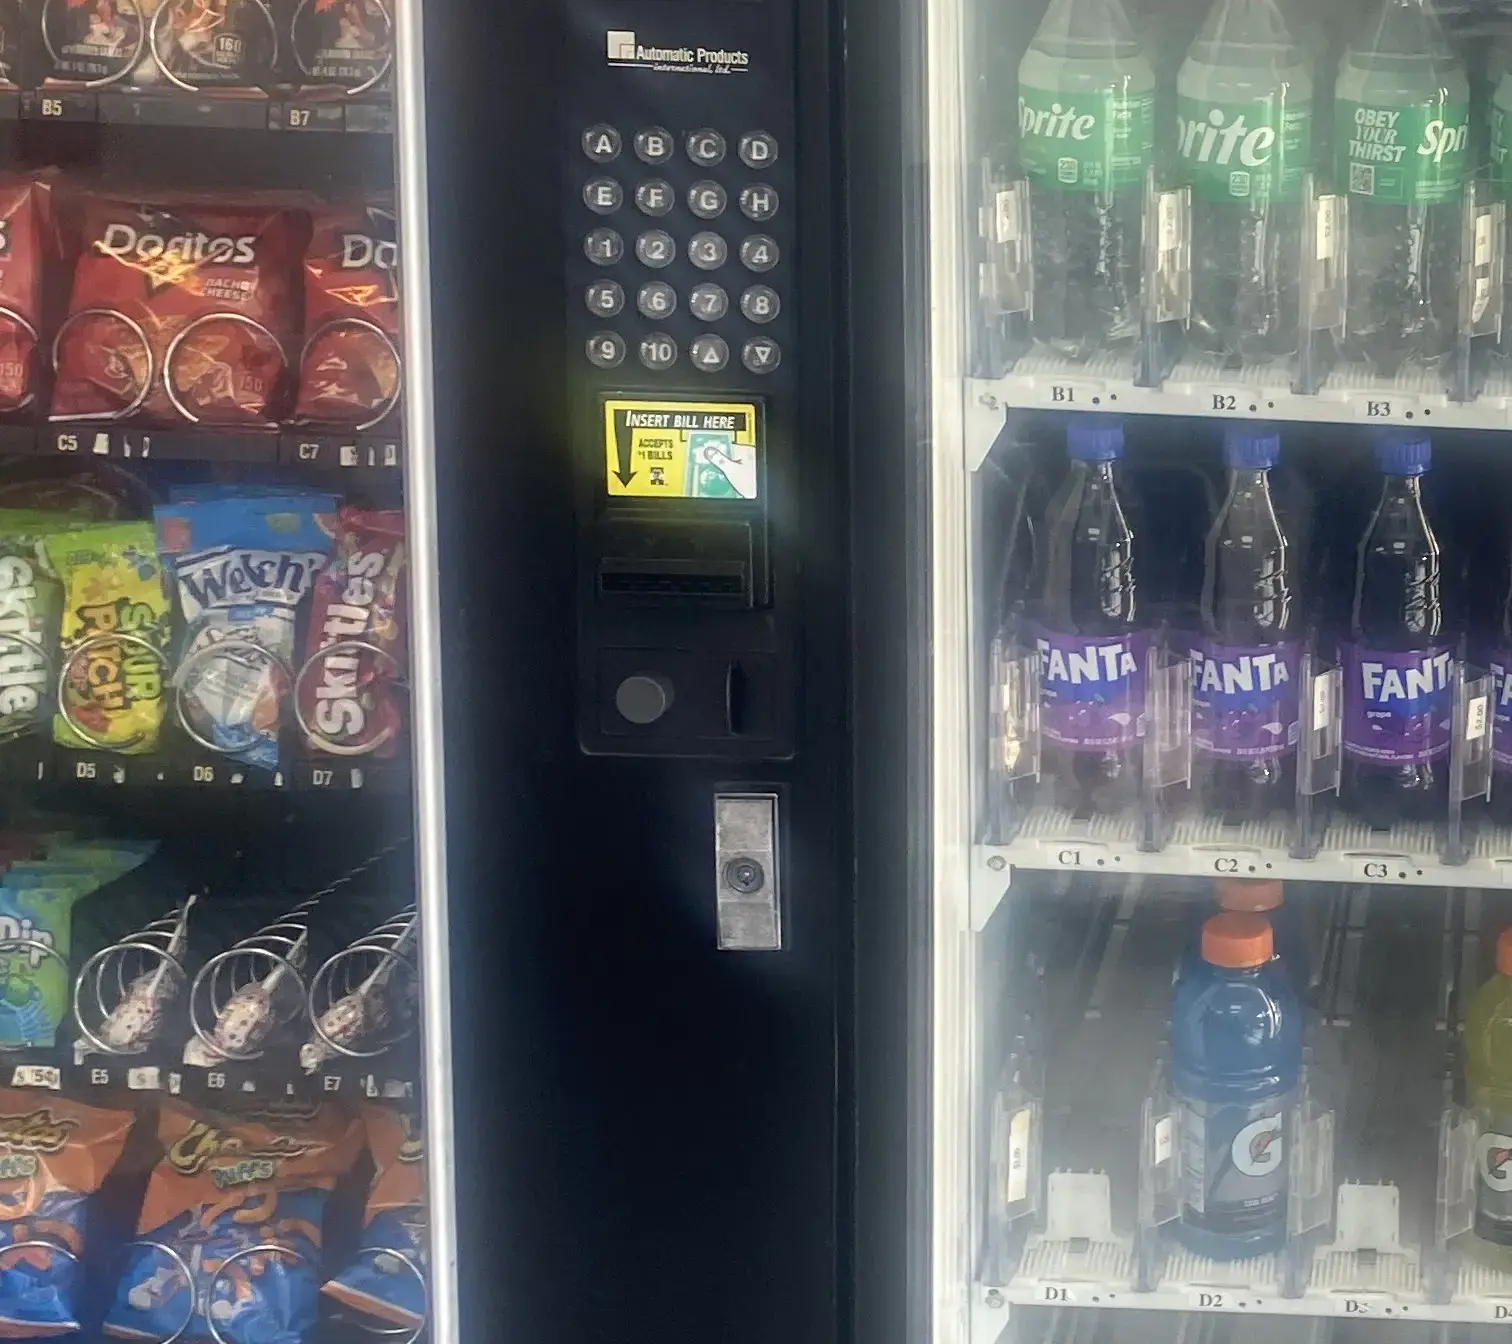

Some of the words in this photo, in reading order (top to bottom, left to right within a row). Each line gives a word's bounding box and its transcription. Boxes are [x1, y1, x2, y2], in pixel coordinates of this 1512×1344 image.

[637, 46, 694, 62] Automatic
[697, 49, 748, 65] Products
[1354, 108, 1399, 128] OBEY
[1355, 127, 1397, 144] YOUR
[595, 134, 612, 153] A
[648, 137, 663, 156] B
[700, 139, 716, 158] C
[753, 141, 767, 160] D
[1348, 140, 1406, 163] THIRST
[598, 187, 613, 206] E
[649, 189, 663, 208] F
[701, 191, 718, 210] G
[753, 193, 768, 211] H
[104, 224, 257, 263] Doritos
[602, 239, 611, 257] 1
[652, 241, 665, 259] 2
[704, 243, 715, 261] 3
[753, 245, 768, 263] 4
[601, 290, 613, 308] 5
[653, 292, 665, 310] 6
[705, 295, 717, 311] 7
[756, 296, 768, 314] 8
[602, 341, 615, 359] 9
[650, 343, 671, 362] 10
[1051, 386, 1075, 402] B1
[1212, 394, 1236, 410] B2
[626, 411, 669, 427] INSERT
[674, 413, 699, 428] BILL
[703, 415, 735, 429] HERE
[638, 439, 673, 448] ACCEPTS
[648, 451, 672, 460] BILLS
[1037, 638, 1137, 684] FANTA
[1190, 648, 1290, 695] FANTA
[76, 762, 96, 779] D5
[194, 767, 213, 782] D6
[313, 771, 333, 785] D7
[1058, 851, 1081, 865] C1
[1214, 859, 1238, 873] C2
[1364, 864, 1388, 879] C3
[1045, 1287, 1067, 1301] D1
[1199, 1293, 1223, 1308] D2
